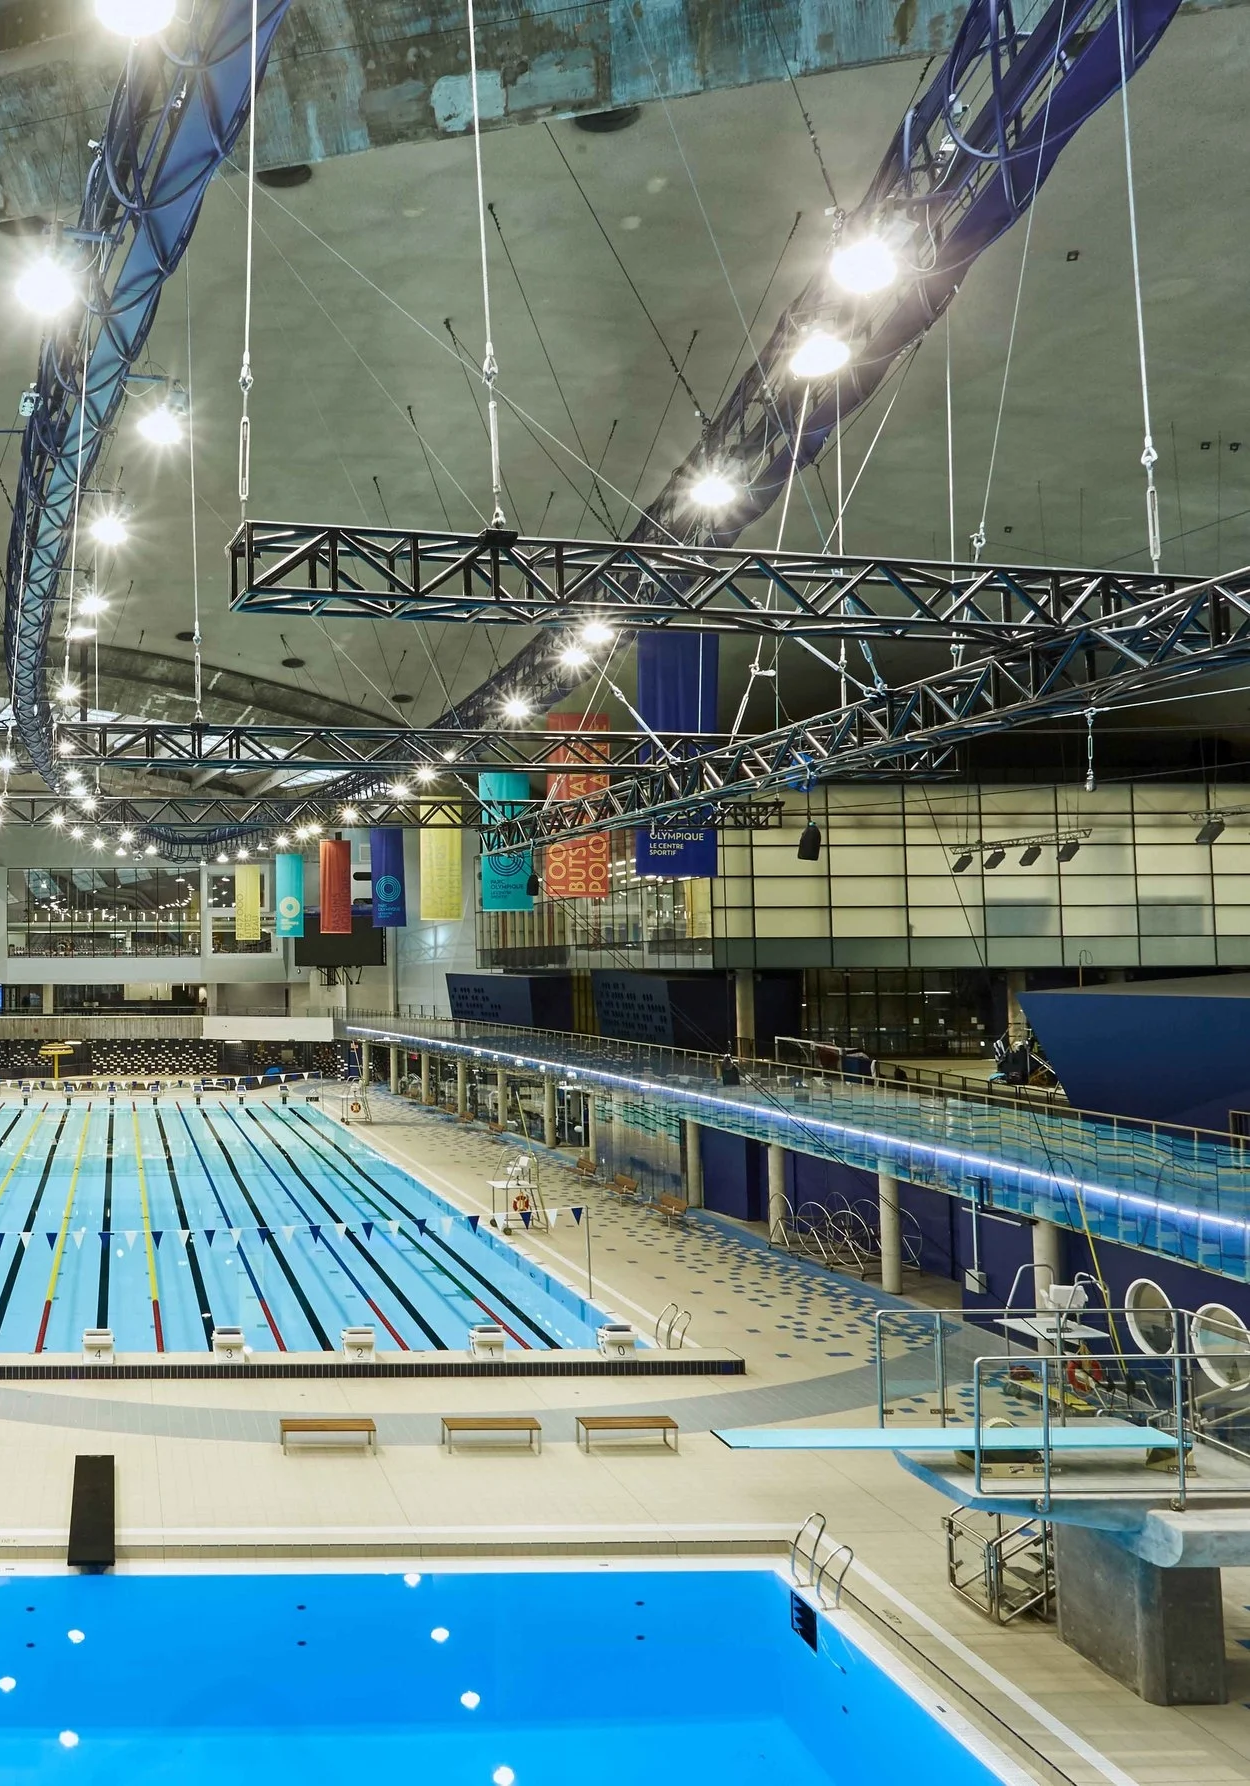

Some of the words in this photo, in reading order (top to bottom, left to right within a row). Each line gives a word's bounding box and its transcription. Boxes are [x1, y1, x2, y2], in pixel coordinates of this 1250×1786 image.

[650, 832, 704, 841] OLYMPIQUE
[568, 846, 587, 892] BUTS
[588, 835, 607, 893] POLO
[94, 1350, 102, 1360] 4
[225, 1349, 233, 1359] 3
[356, 1349, 364, 1359] 2
[488, 1347, 495, 1357] 1
[617, 1346, 625, 1356] 0
